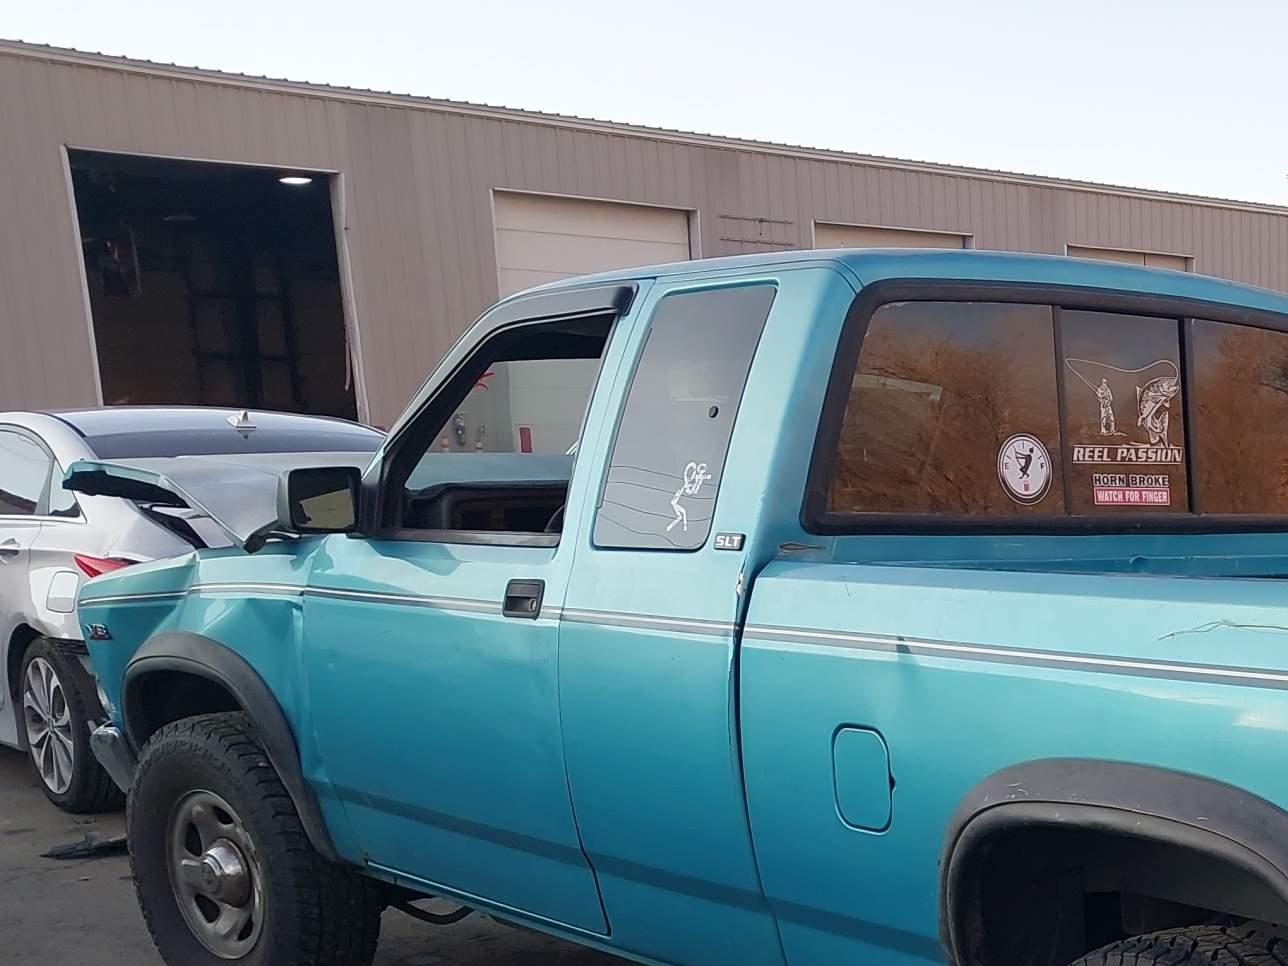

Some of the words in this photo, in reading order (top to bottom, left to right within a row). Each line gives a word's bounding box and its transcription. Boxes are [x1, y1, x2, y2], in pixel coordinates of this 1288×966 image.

[1073, 447, 1111, 461] REEL
[1117, 448, 1183, 462] PASSION
[1093, 474, 1126, 487] HORN
[1129, 475, 1169, 487] BROKE
[1097, 489, 1123, 502] WATCH
[1125, 490, 1140, 502] FOR
[1142, 490, 1168, 503] FINGER
[716, 535, 741, 547] SLT
